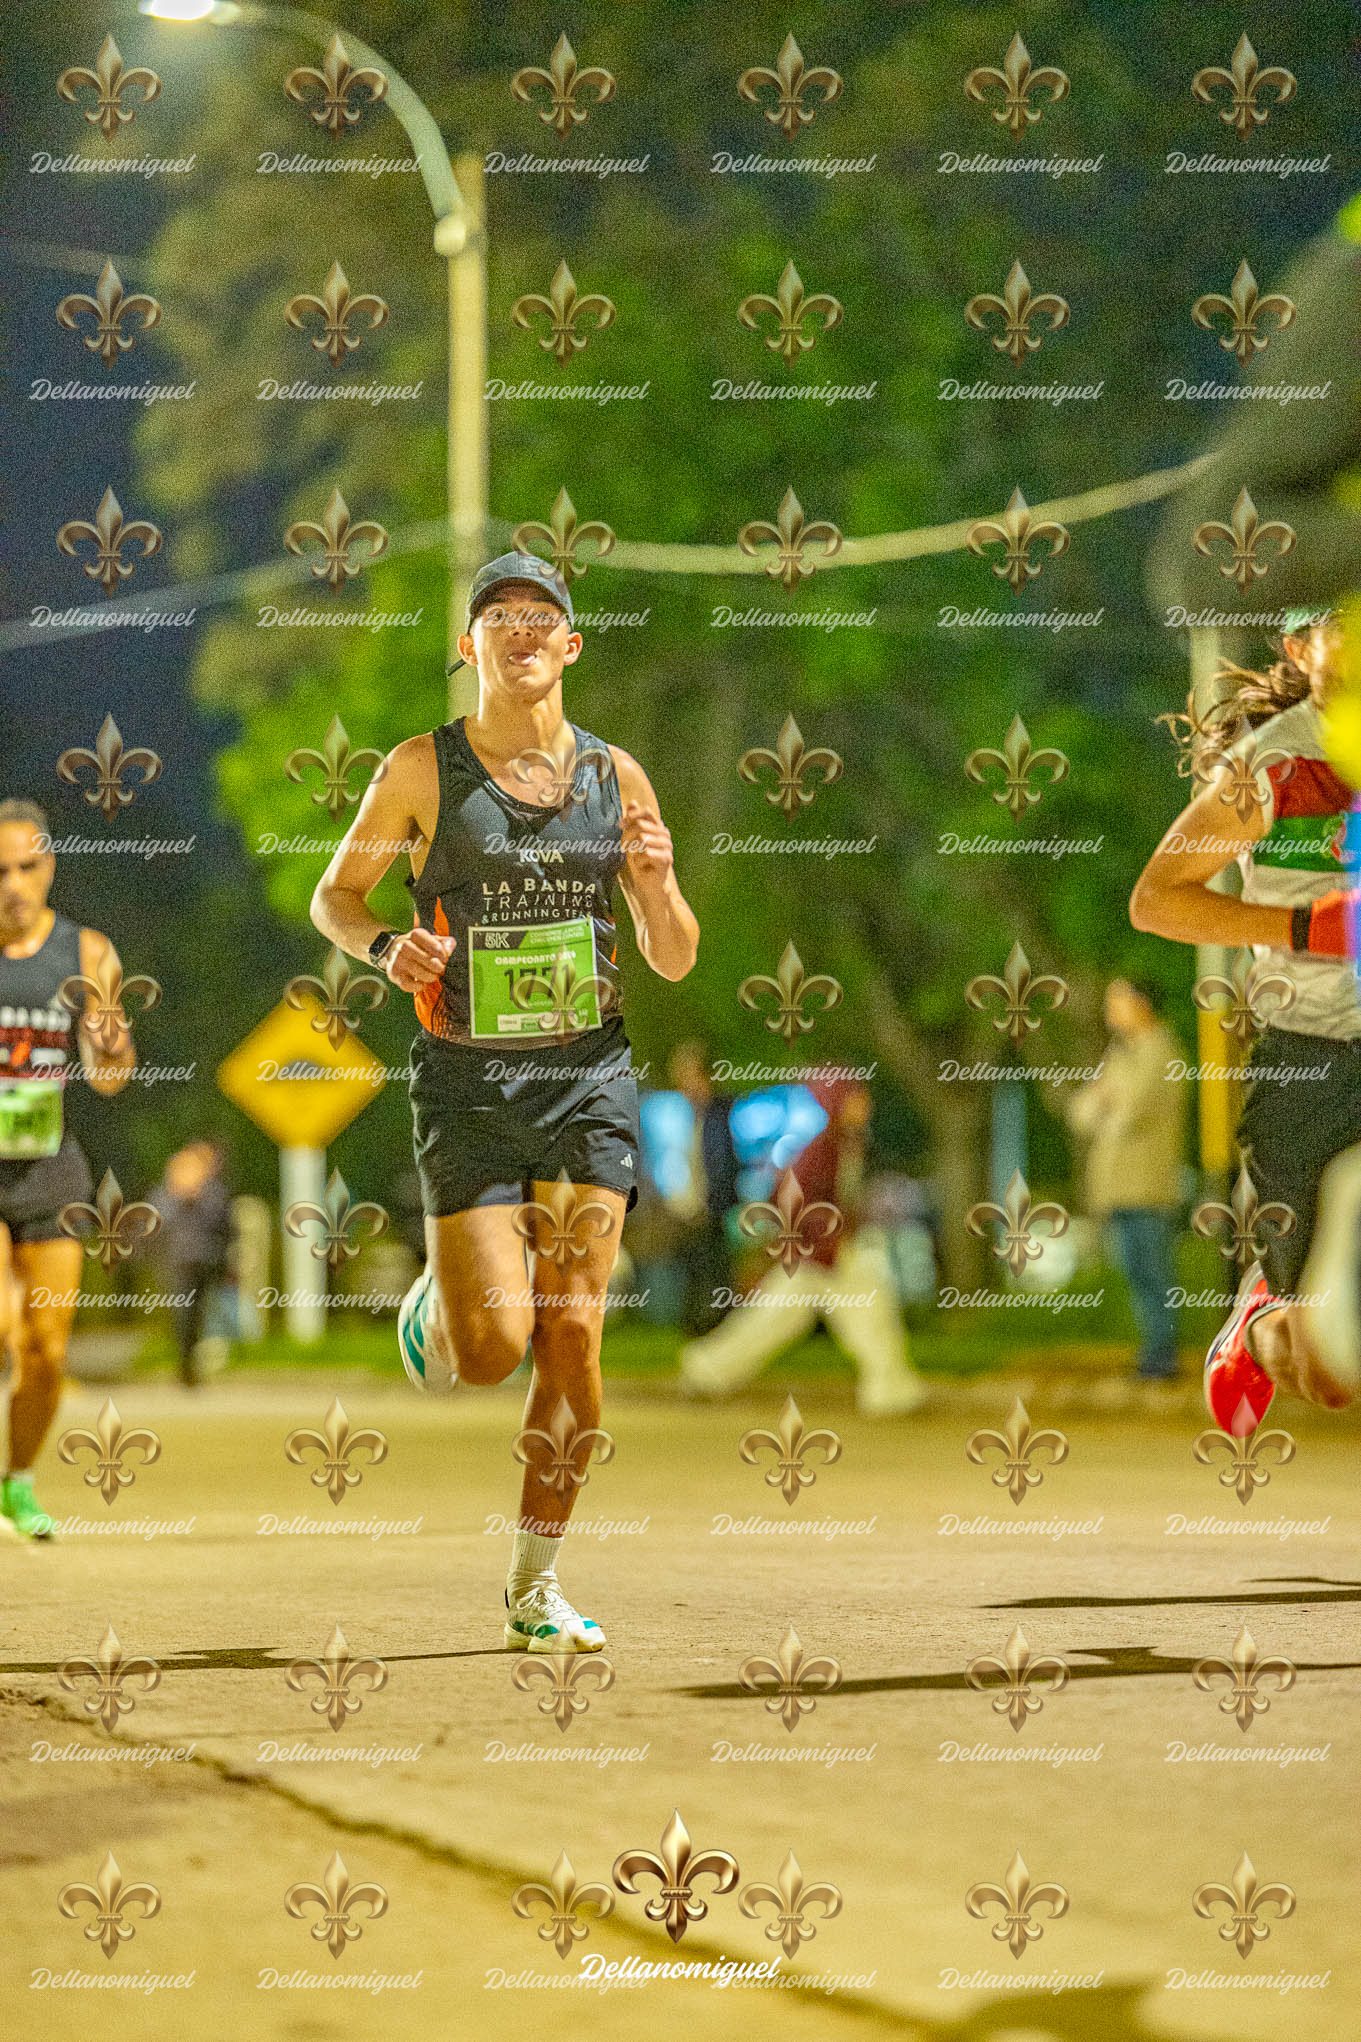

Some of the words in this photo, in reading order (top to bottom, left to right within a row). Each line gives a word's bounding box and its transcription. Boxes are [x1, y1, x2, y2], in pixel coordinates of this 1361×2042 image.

[520, 848, 564, 862] KOVA
[482, 881, 511, 895] LA
[524, 878, 596, 894] BANDA
[485, 932, 510, 948] 5K
